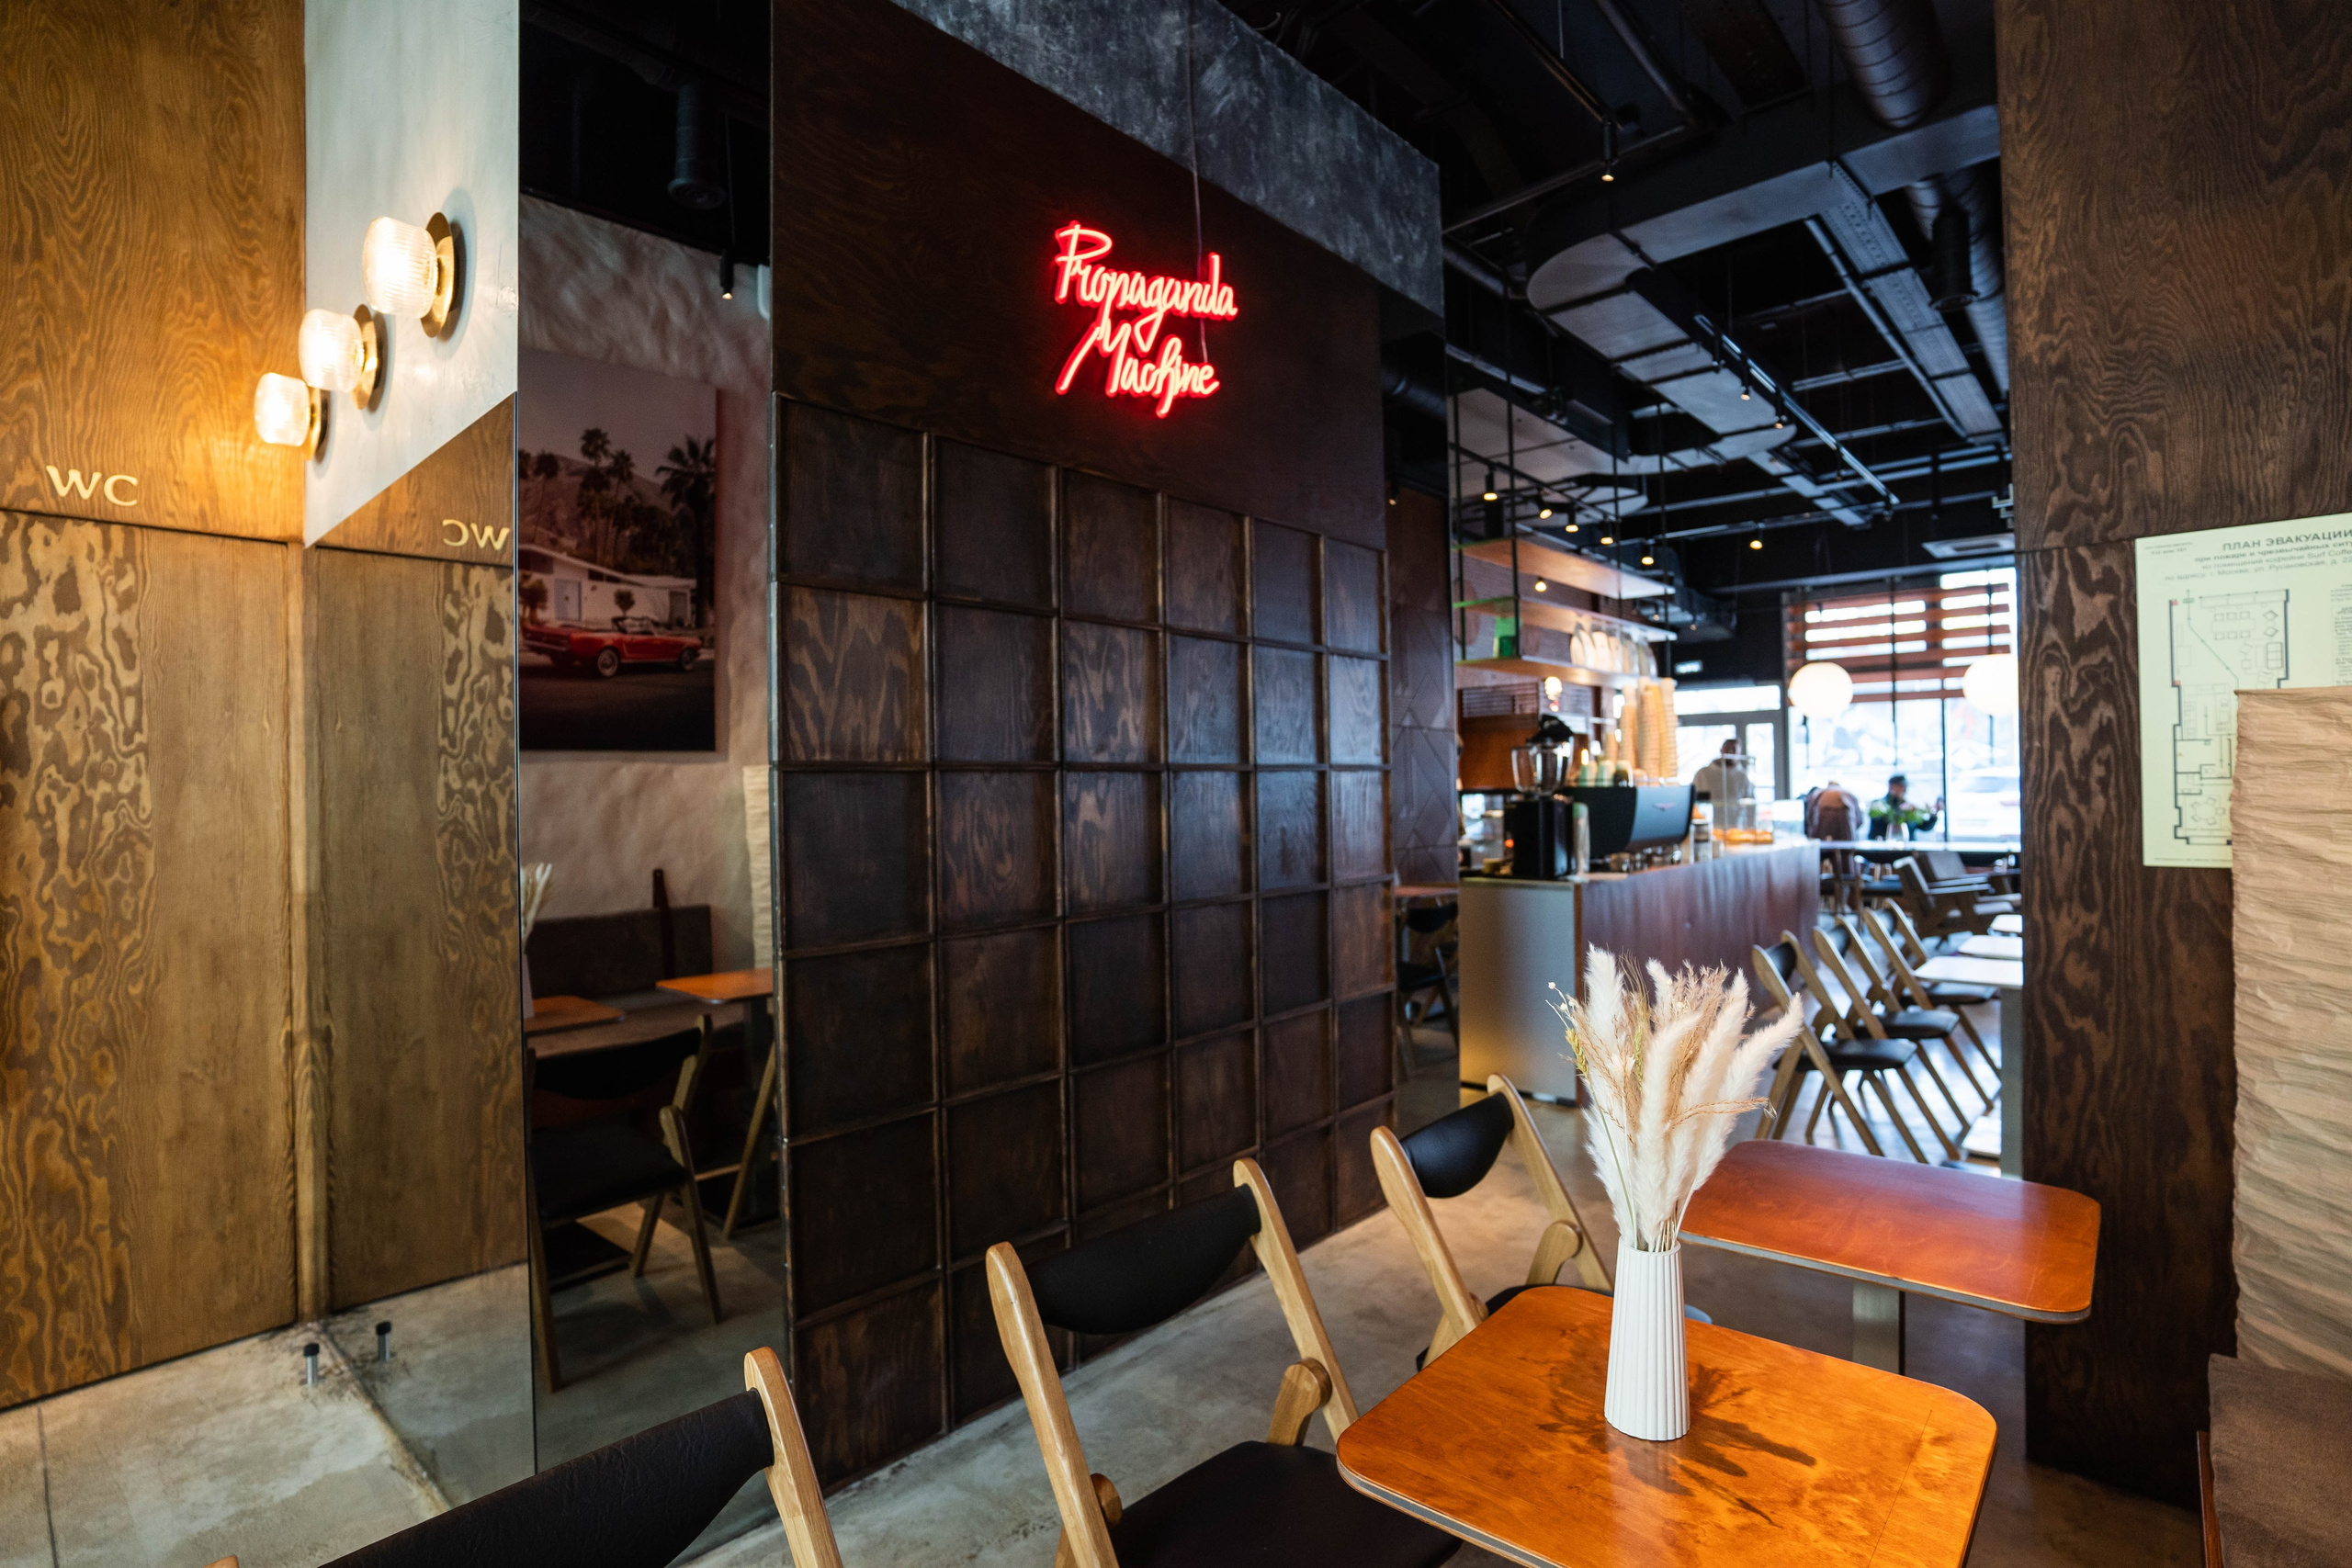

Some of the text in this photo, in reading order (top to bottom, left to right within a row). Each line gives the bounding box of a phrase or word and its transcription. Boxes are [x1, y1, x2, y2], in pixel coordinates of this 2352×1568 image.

[1054, 220, 1238, 357] Propaganda
[1055, 317, 1220, 418] Machine
[46, 465, 138, 507] WC
[2214, 552, 2246, 560] пожаре
[2258, 544, 2329, 557] чрезвычайных
[2222, 529, 2352, 551] ПЛАН ЭВАКУАЦИИ
